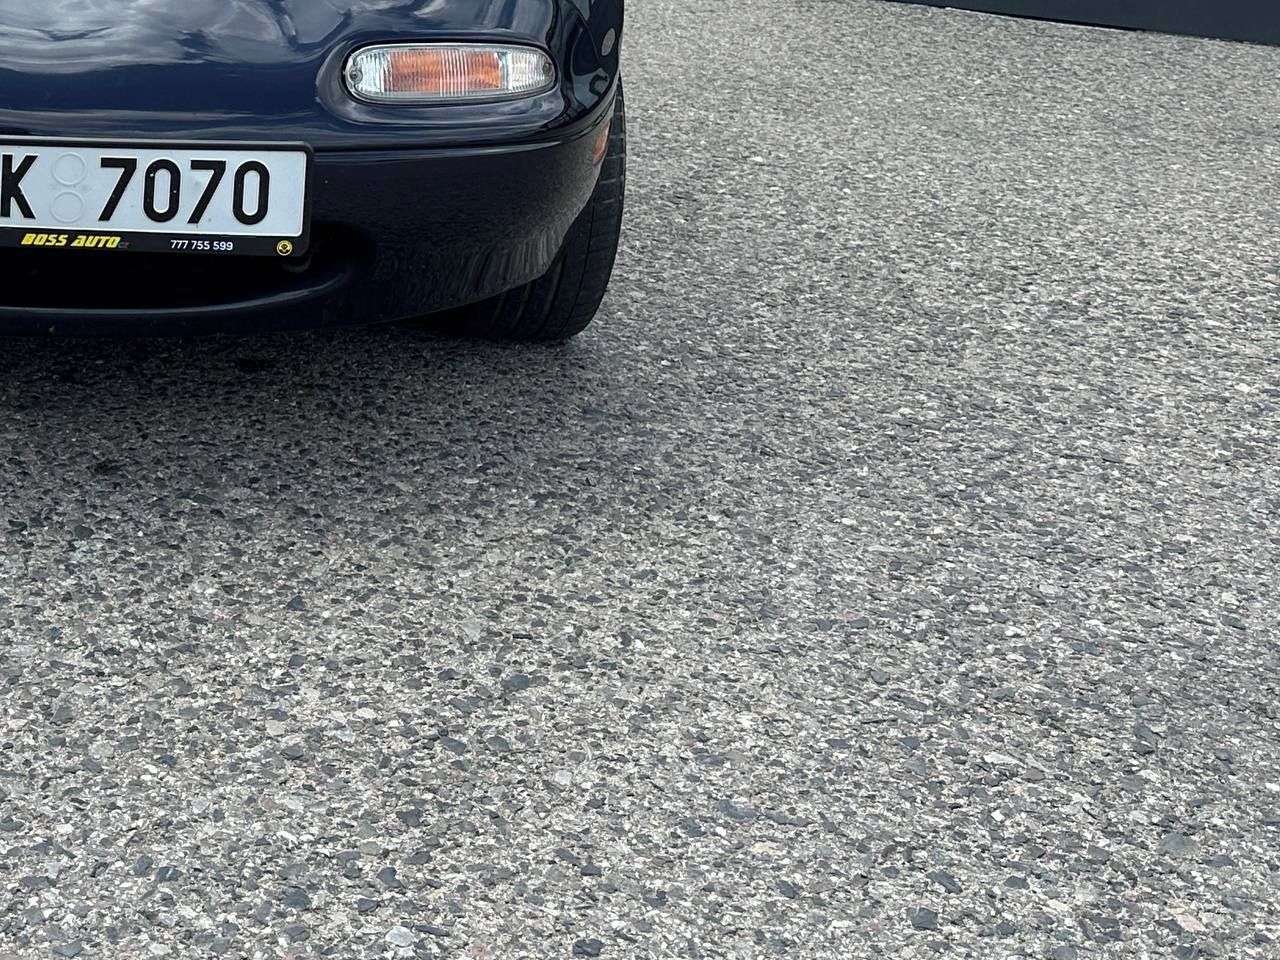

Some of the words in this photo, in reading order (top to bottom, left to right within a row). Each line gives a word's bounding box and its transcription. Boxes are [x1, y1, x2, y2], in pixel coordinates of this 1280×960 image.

[98, 157, 271, 226] 7070
[21, 233, 69, 247] BOSS
[70, 235, 121, 249] AUTO
[170, 239, 189, 250] 777
[191, 240, 211, 251] 755
[212, 241, 234, 252] 599
